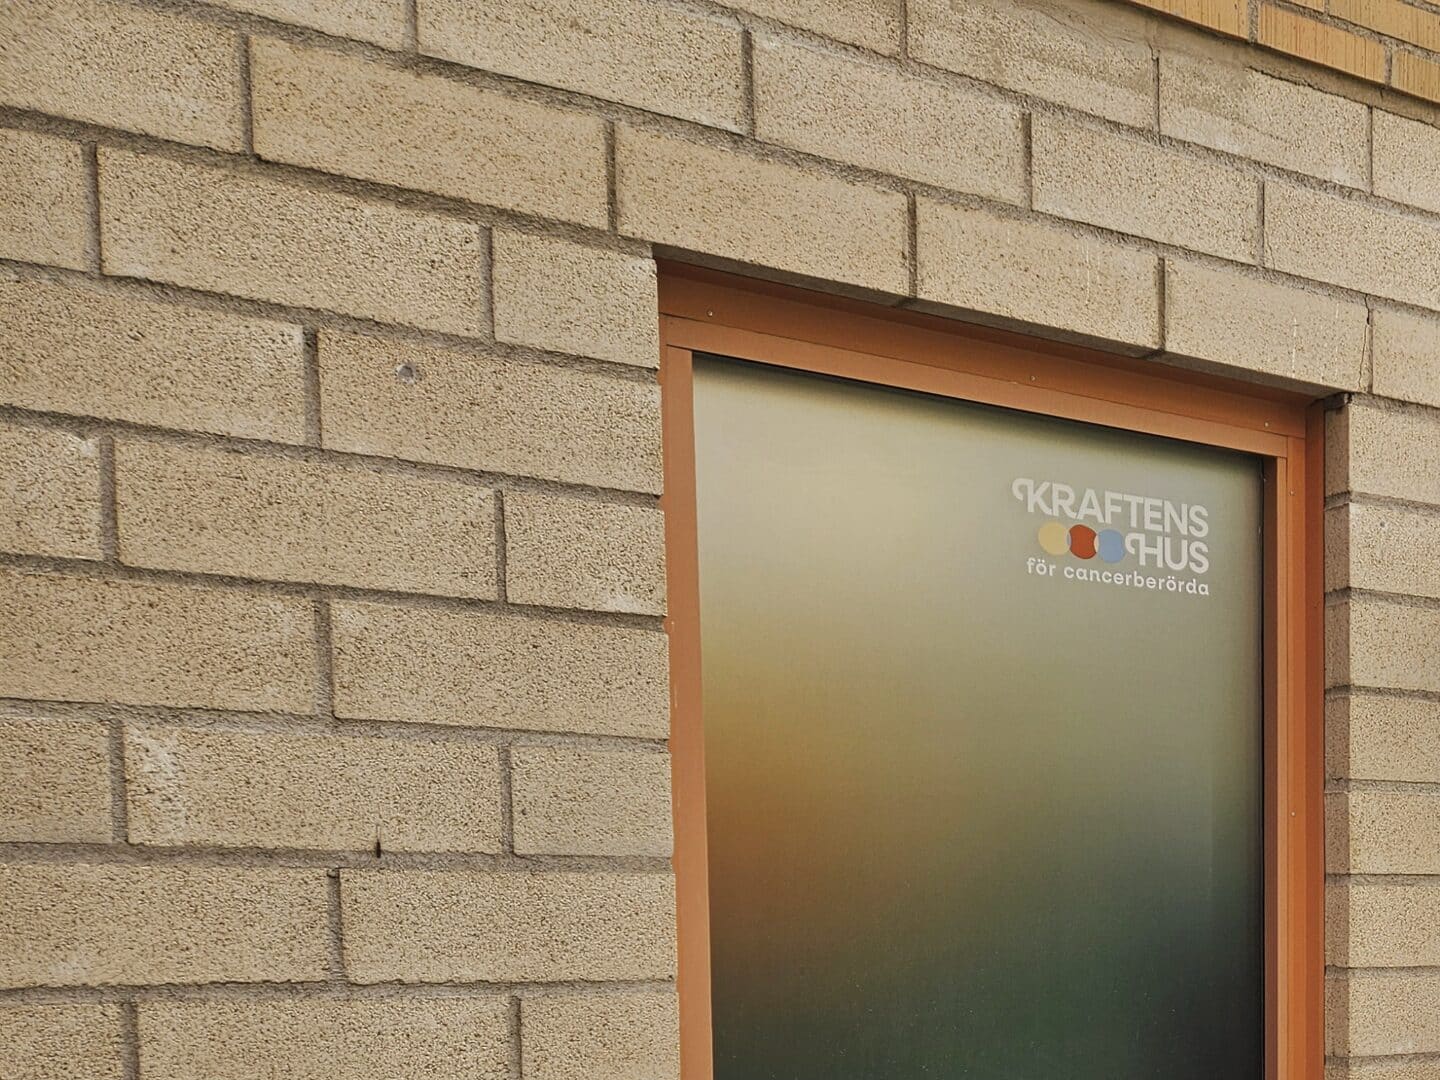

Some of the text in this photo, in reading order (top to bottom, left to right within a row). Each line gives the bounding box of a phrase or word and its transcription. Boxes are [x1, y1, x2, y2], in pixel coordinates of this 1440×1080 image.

[1011, 477, 1209, 538] KRAFTENS
[1125, 532, 1209, 574] HUS
[1026, 557, 1209, 596] för cancerberörda
